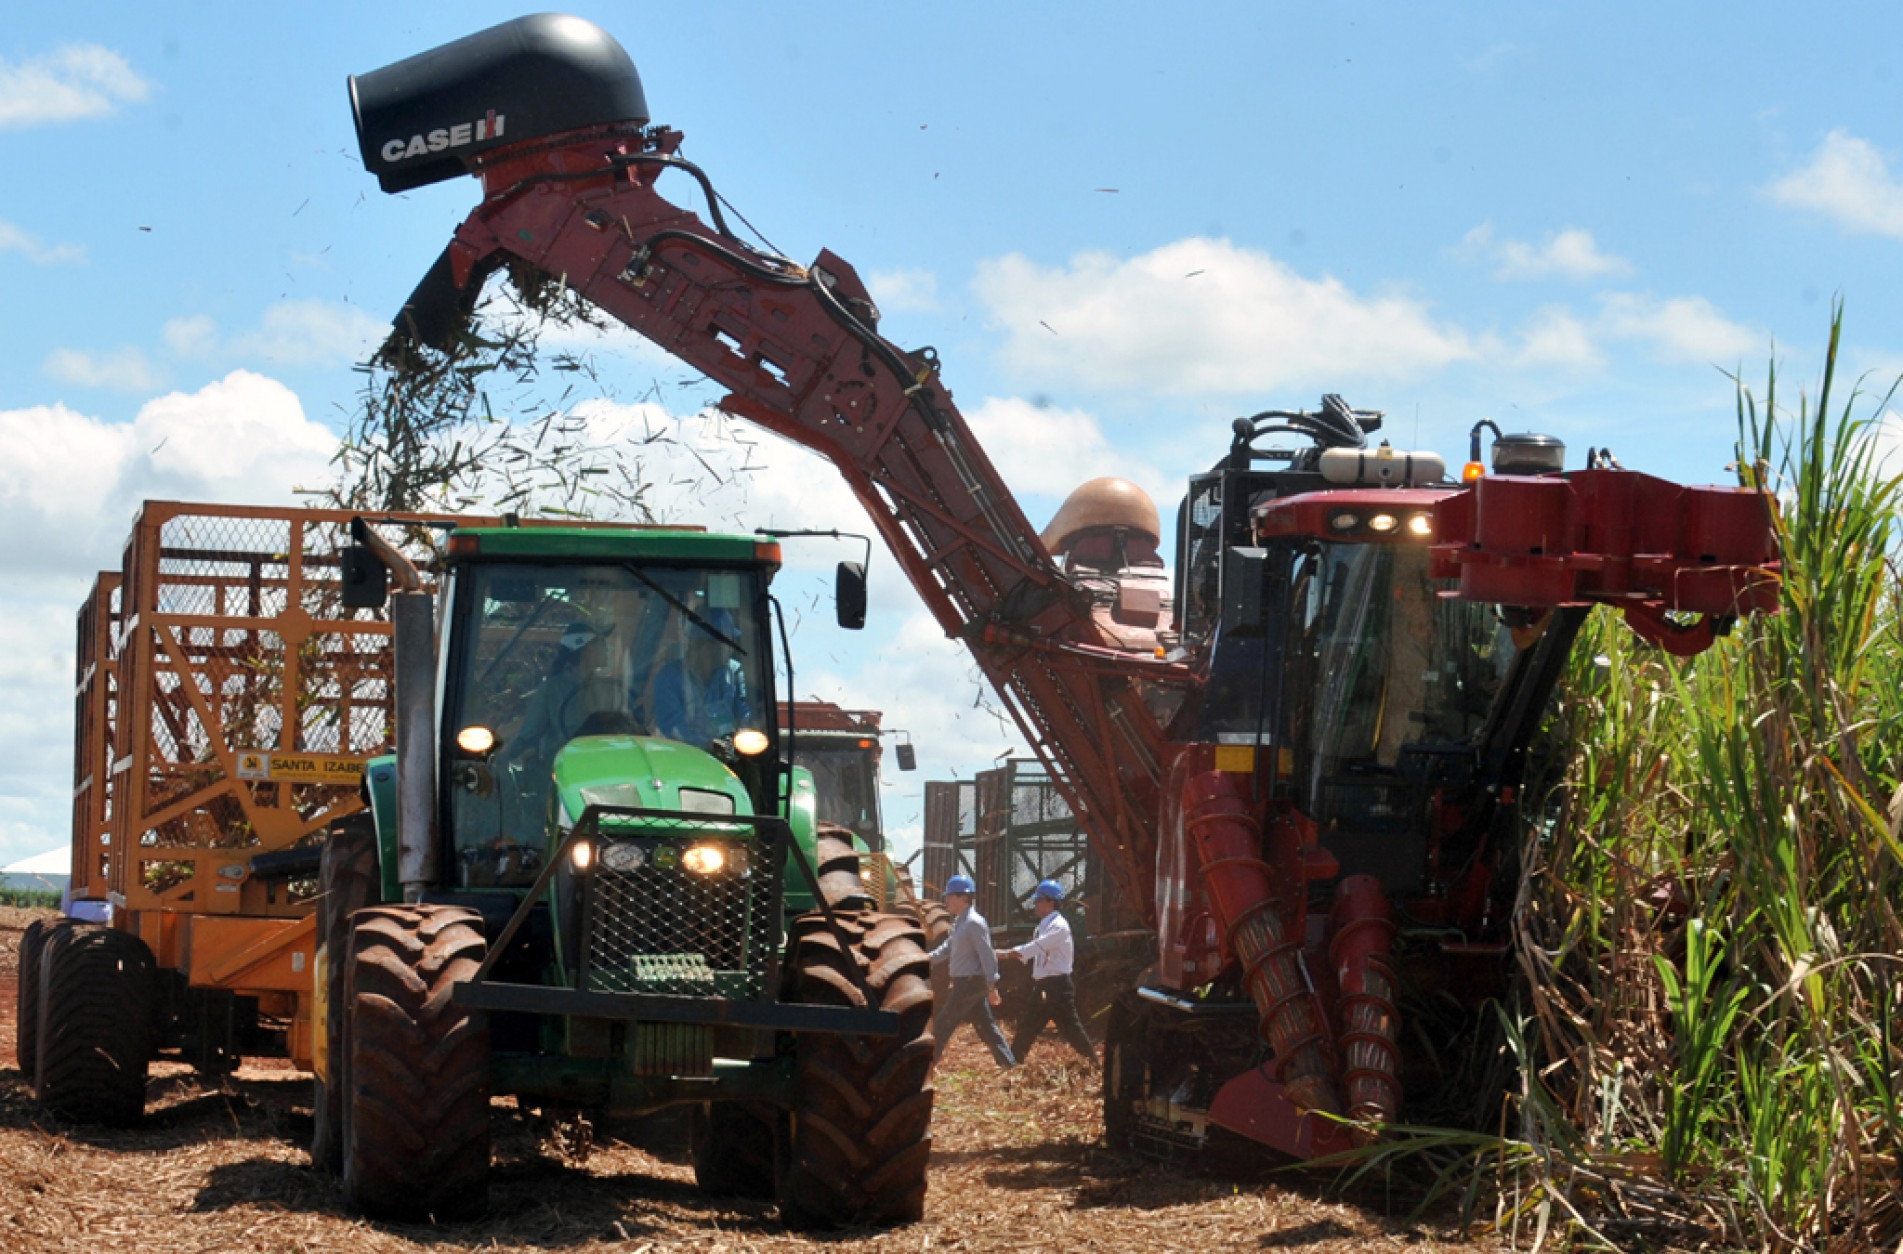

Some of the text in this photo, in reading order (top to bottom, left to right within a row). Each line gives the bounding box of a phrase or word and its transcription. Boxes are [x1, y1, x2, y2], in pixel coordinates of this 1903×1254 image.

[381, 122, 472, 162] CASE
[271, 758, 316, 772] SANTA
[324, 760, 365, 774] IZABE
